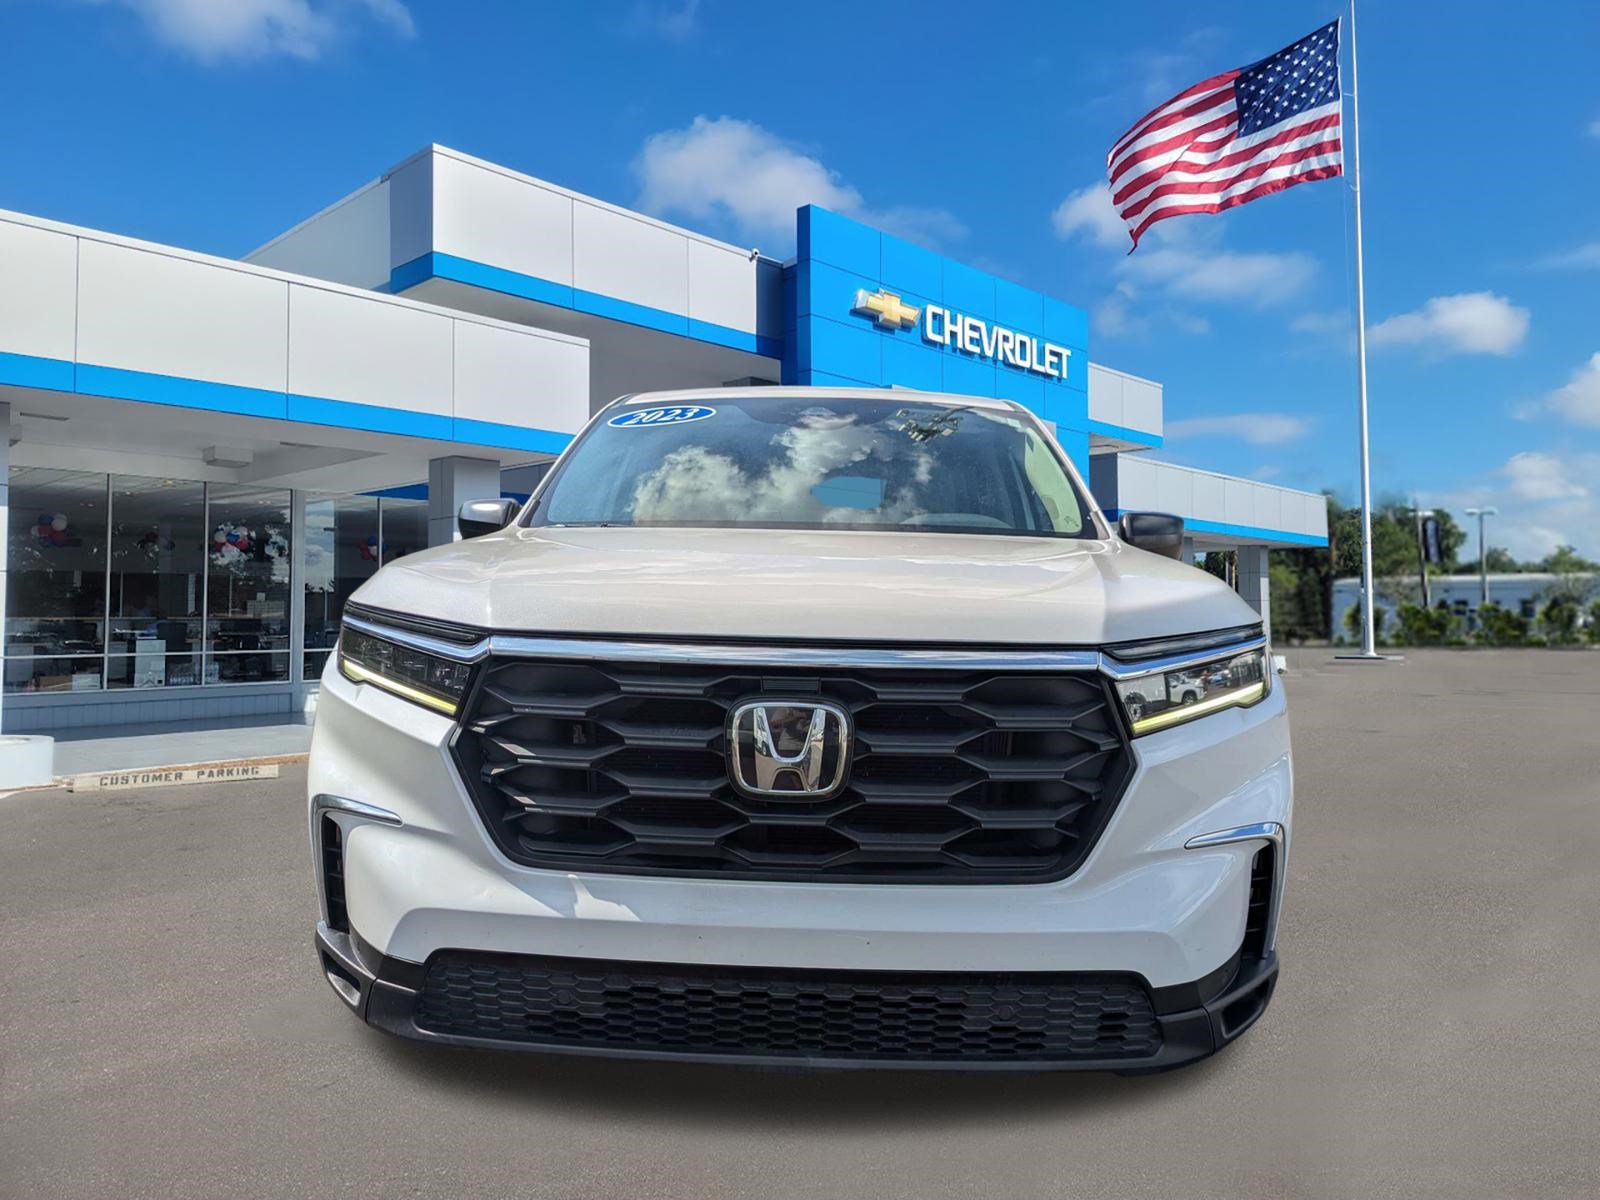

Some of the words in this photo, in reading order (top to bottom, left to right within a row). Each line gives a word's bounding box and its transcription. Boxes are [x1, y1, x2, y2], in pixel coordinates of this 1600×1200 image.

[925, 304, 1072, 379] CHEVROLET
[621, 408, 700, 425] 2023
[99, 771, 184, 786] CUSTOMER
[196, 766, 260, 779] PARKING
